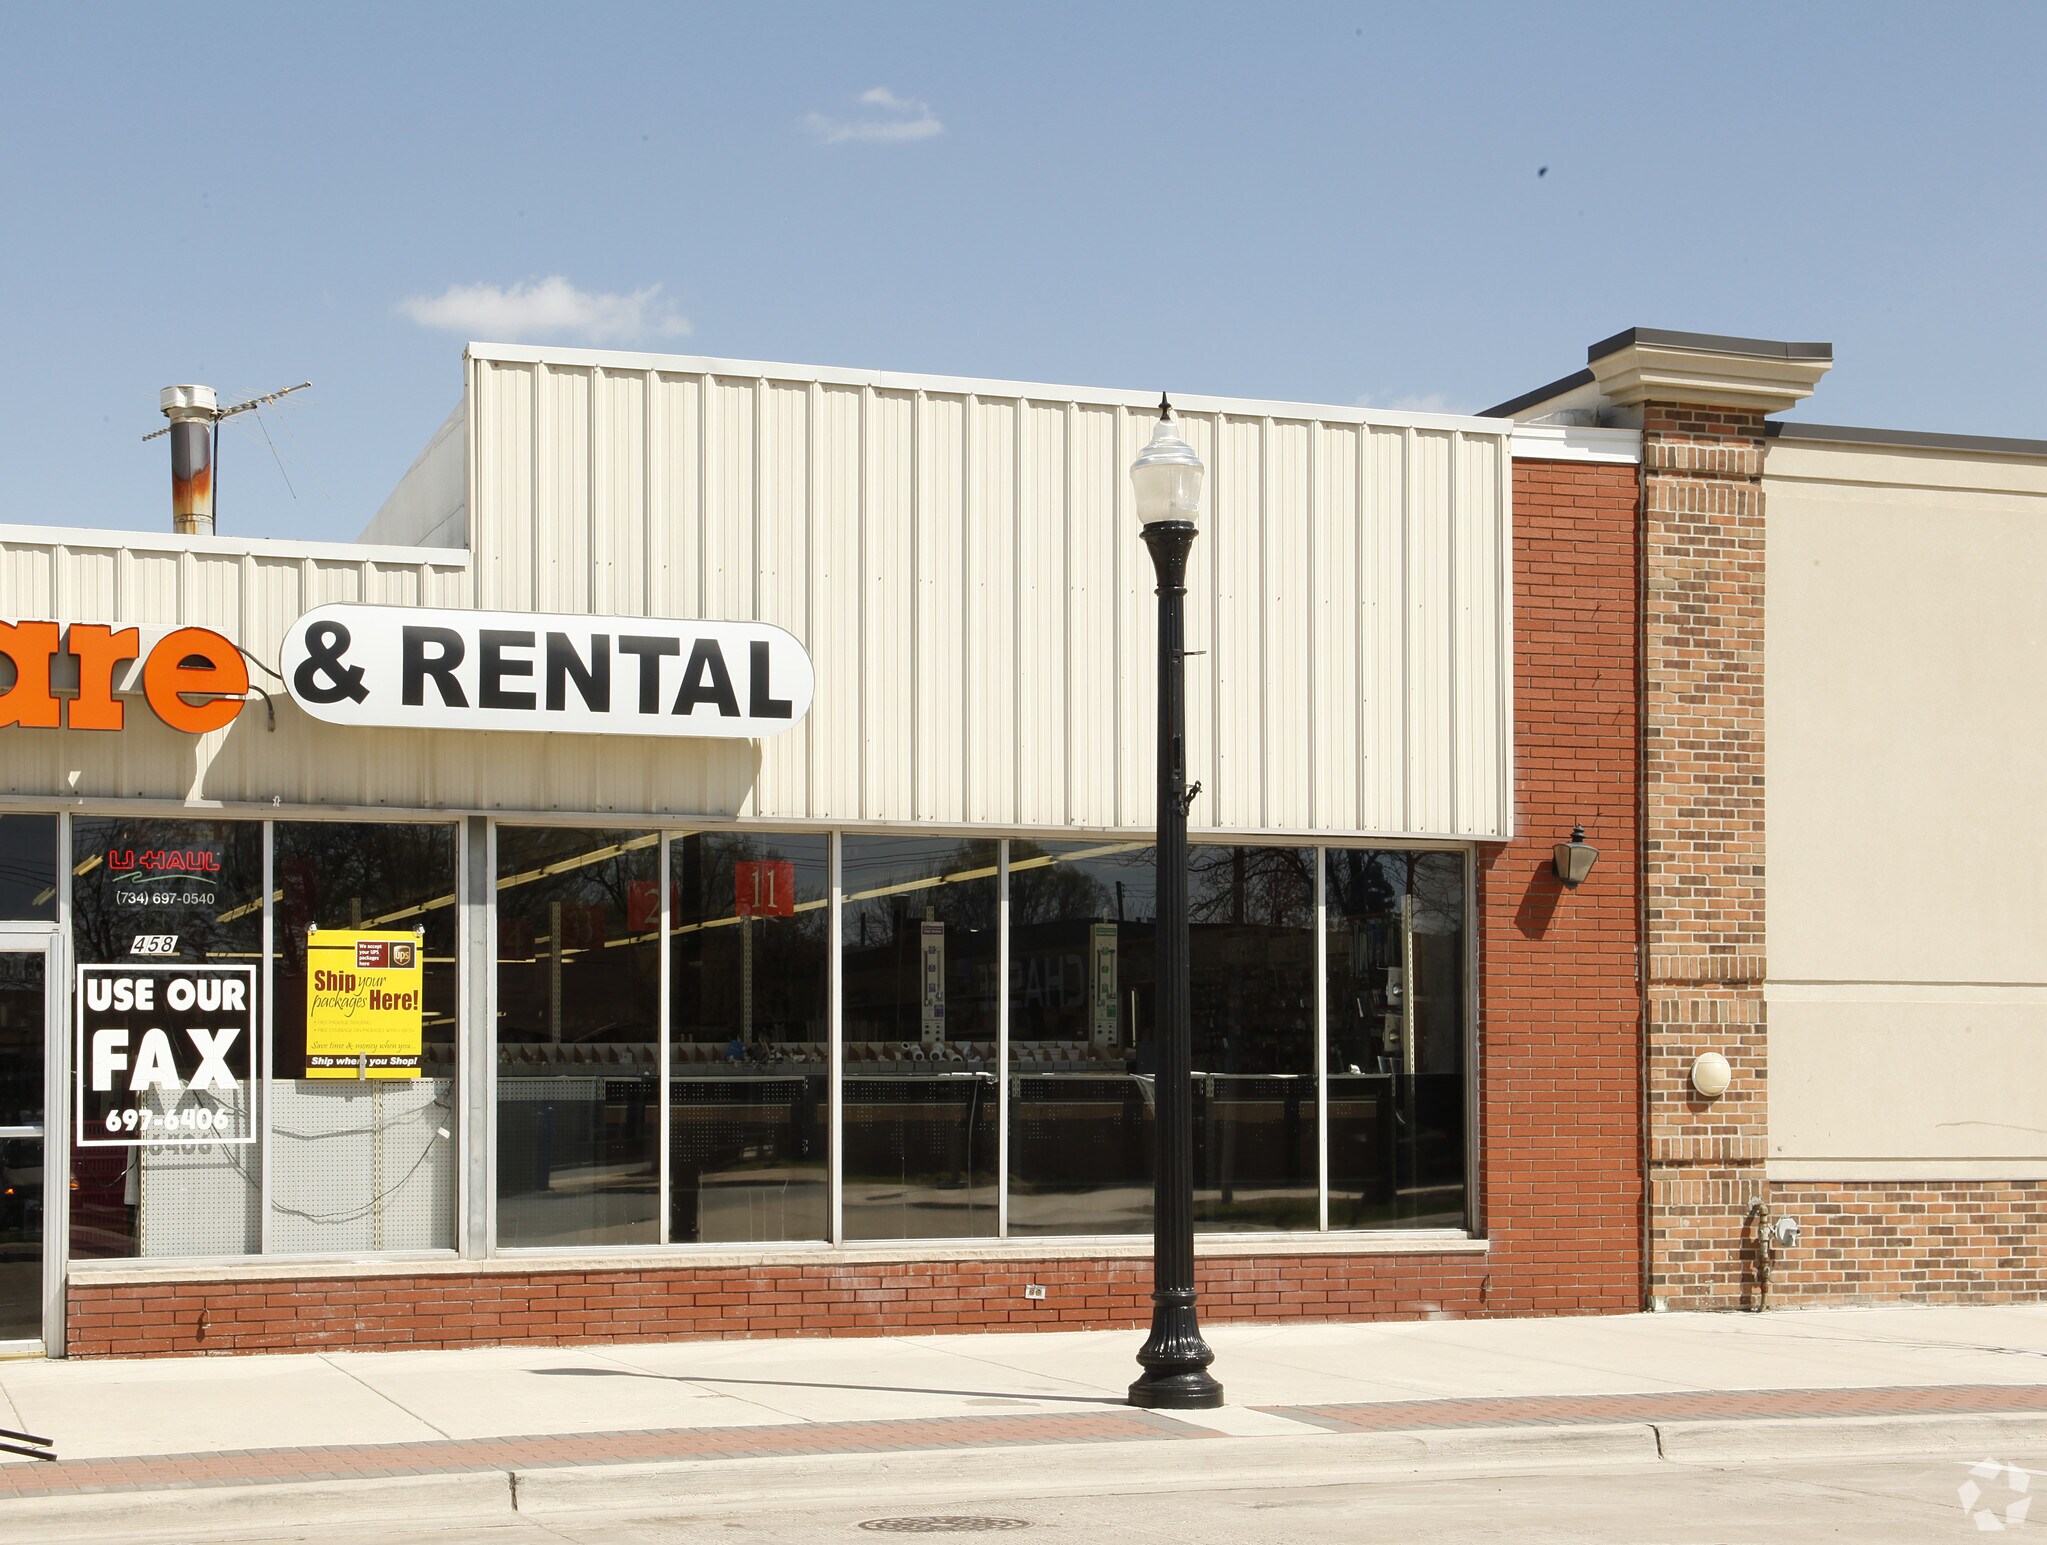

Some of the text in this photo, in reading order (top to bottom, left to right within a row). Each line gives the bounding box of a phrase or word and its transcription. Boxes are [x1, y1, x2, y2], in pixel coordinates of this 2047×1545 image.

[293, 620, 793, 719] & RENTAL
[116, 890, 215, 905] (734) 697-0540
[752, 867, 778, 908] 11
[133, 936, 173, 952] 458
[87, 978, 246, 1011] USE OUR
[314, 970, 386, 996] Ship your
[311, 989, 419, 1017] packages Here!
[92, 1028, 241, 1091] FAX
[311, 1041, 328, 1049] Save
[329, 1041, 344, 1049] time
[345, 1042, 353, 1050] &
[355, 1043, 378, 1053] money
[379, 1040, 396, 1049] when
[311, 1056, 334, 1067] Ship
[368, 1058, 387, 1067] you
[389, 1056, 418, 1067] Shop!
[105, 1108, 229, 1132] 697-6406
